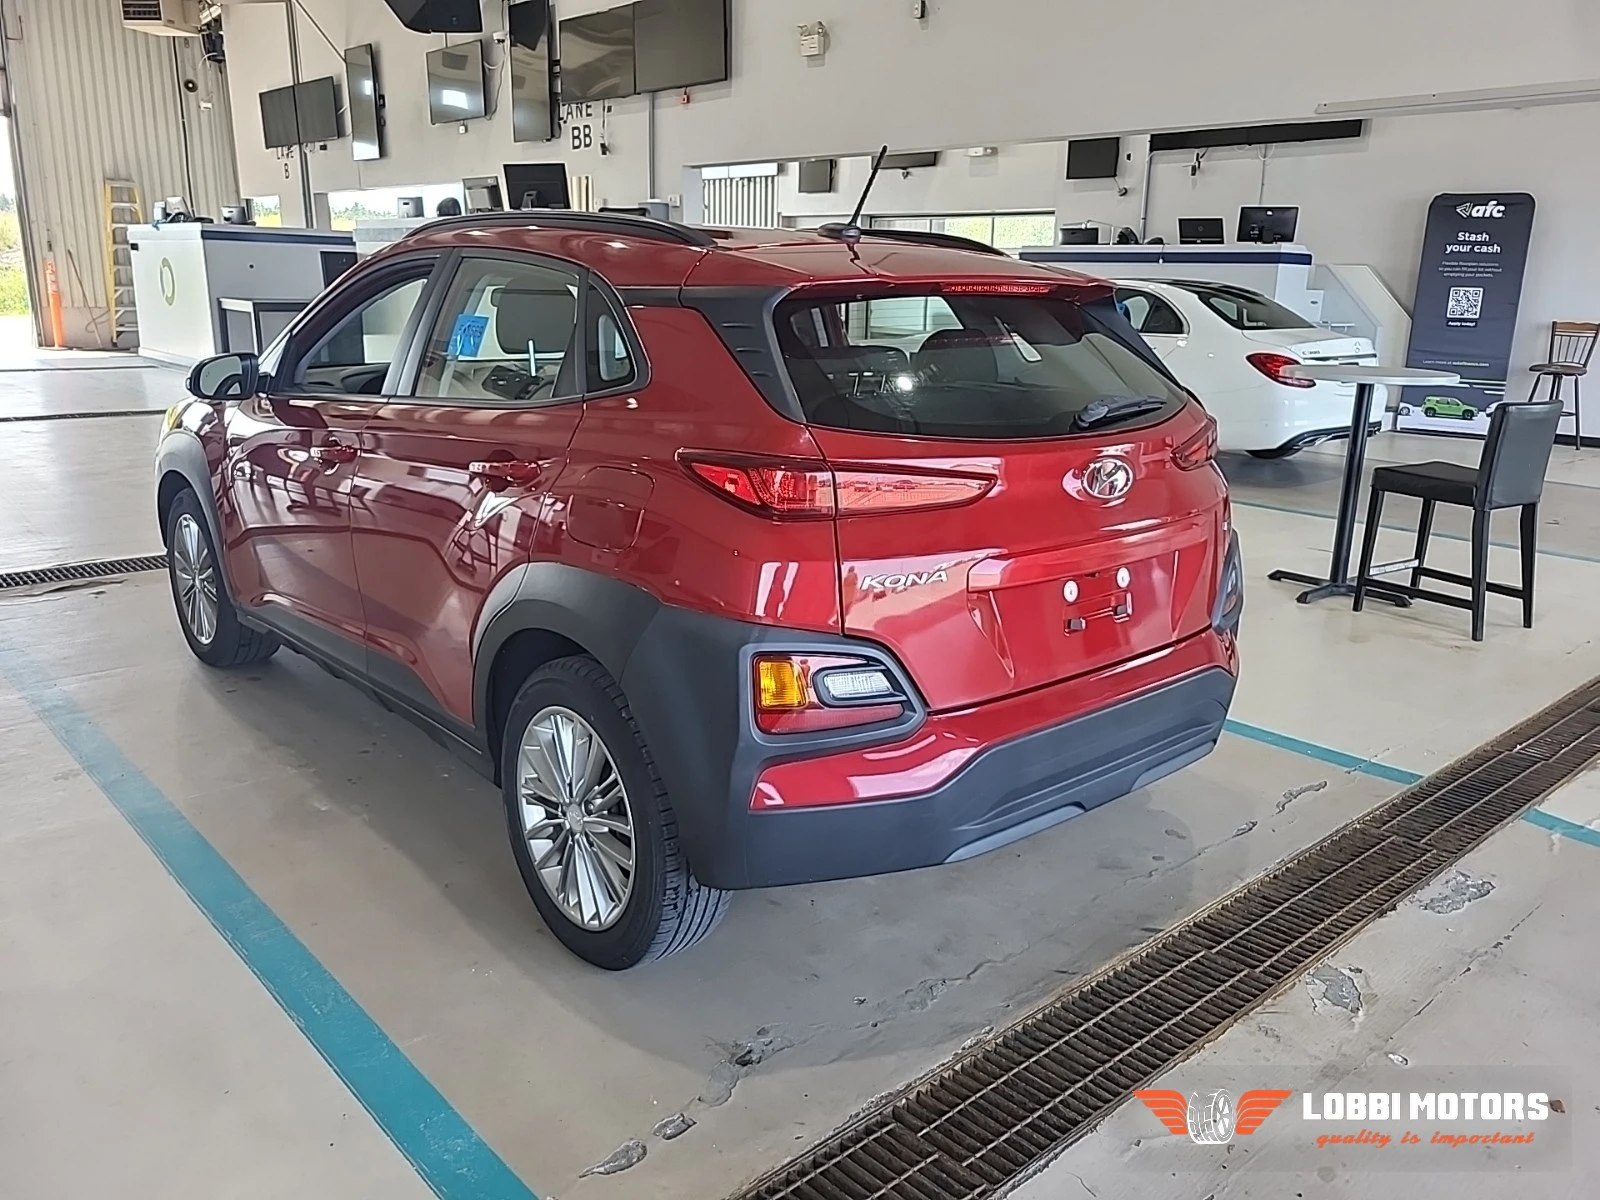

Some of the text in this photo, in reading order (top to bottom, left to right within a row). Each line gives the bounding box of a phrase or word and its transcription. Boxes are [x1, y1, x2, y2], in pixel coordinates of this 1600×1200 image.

[571, 124, 593, 150] BB
[1471, 200, 1505, 218] afc
[1457, 231, 1489, 242] Stash
[1445, 243, 1501, 254] your cash
[860, 570, 948, 591] KONA
